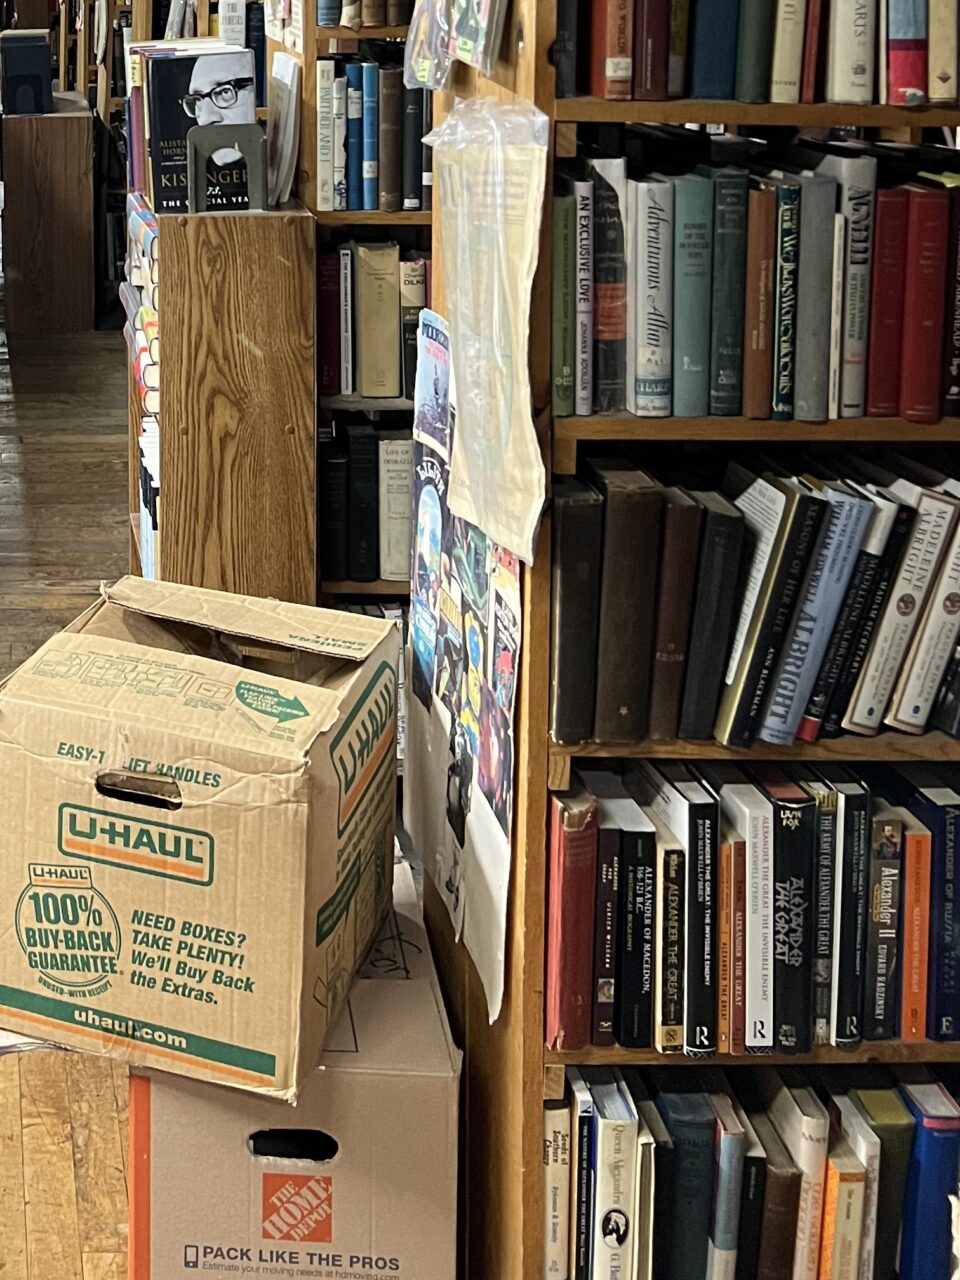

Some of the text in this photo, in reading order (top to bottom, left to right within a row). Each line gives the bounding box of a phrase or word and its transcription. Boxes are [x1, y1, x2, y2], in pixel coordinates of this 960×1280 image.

[618, 14, 628, 54] WORLDS
[160, 170, 248, 188] KISNGER
[579, 194, 590, 211] AN
[578, 215, 590, 273] EXCLUSIVE
[848, 188, 873, 265] AGNELLI
[646, 188, 671, 348] Adventurous Allia
[578, 278, 590, 304] LOVE
[579, 320, 589, 355] JOHANNA
[821, 500, 845, 550] WILLIAM
[902, 508, 933, 585] ALBRIGHT
[772, 505, 819, 633] SEASONS OF HER LIFE
[912, 508, 947, 593] MADELEINE
[804, 553, 829, 604] FOXWELL
[852, 558, 878, 622] MADELEINE
[850, 581, 888, 674] MADAM SECRETARY
[768, 610, 818, 725] ALBRIGHT
[827, 628, 856, 684] ALBRIGHT
[749, 648, 776, 716] ANN BLACKMAN
[57, 741, 106, 765] EASY-T
[69, 813, 205, 864] U-HAUL
[761, 815, 770, 864] ALEXANDER
[944, 807, 960, 880] ALEXANDER
[32, 867, 88, 880] U-HAUL
[751, 815, 760, 915] JOHN MAXWELL O'BRIEN
[761, 866, 770, 882] THE
[817, 815, 832, 954] THE ARMY OF ALEXANDER THE GREAT
[28, 892, 103, 927] 100%
[668, 883, 679, 942] ALEXANDER
[944, 883, 954, 899] OF
[26, 926, 115, 953] BUY-BACK
[131, 910, 247, 949] NEED BOXES?
[641, 866, 653, 994] ALEXANDER OF MACEDON,
[761, 914, 770, 930] THE
[774, 880, 789, 964] THE GREAT
[789, 876, 808, 967] ALEXANDER
[874, 867, 900, 1020] Alexander II EDVARD RADZINSKY
[943, 902, 954, 943] RUSSIA
[27, 951, 120, 976] GUARANTEE
[131, 949, 256, 994] We'll Buy Back
[132, 929, 245, 970] TAKE PLENTY!
[668, 945, 679, 965] THE
[761, 931, 770, 971] INVISIBLE
[130, 970, 219, 1005] the Extras.
[667, 968, 678, 1000] GREAT
[720, 942, 728, 1021] ALEXANDER THE GREAT
[761, 973, 770, 1002] ENEMY
[74, 1008, 187, 1049] uhaul.com
[612, 1124, 626, 1205] Queen Alexandra
[262, 1175, 332, 1240] HOME
[269, 1180, 299, 1208] THE
[290, 1201, 332, 1242] DEPOT
[202, 1261, 240, 1273] Estimate
[241, 1265, 261, 1276] your
[262, 1265, 295, 1278] moving
[296, 1268, 323, 1278] needs
[325, 1270, 334, 1278] at
[203, 1245, 400, 1271] PACK LIKE THE PROS
